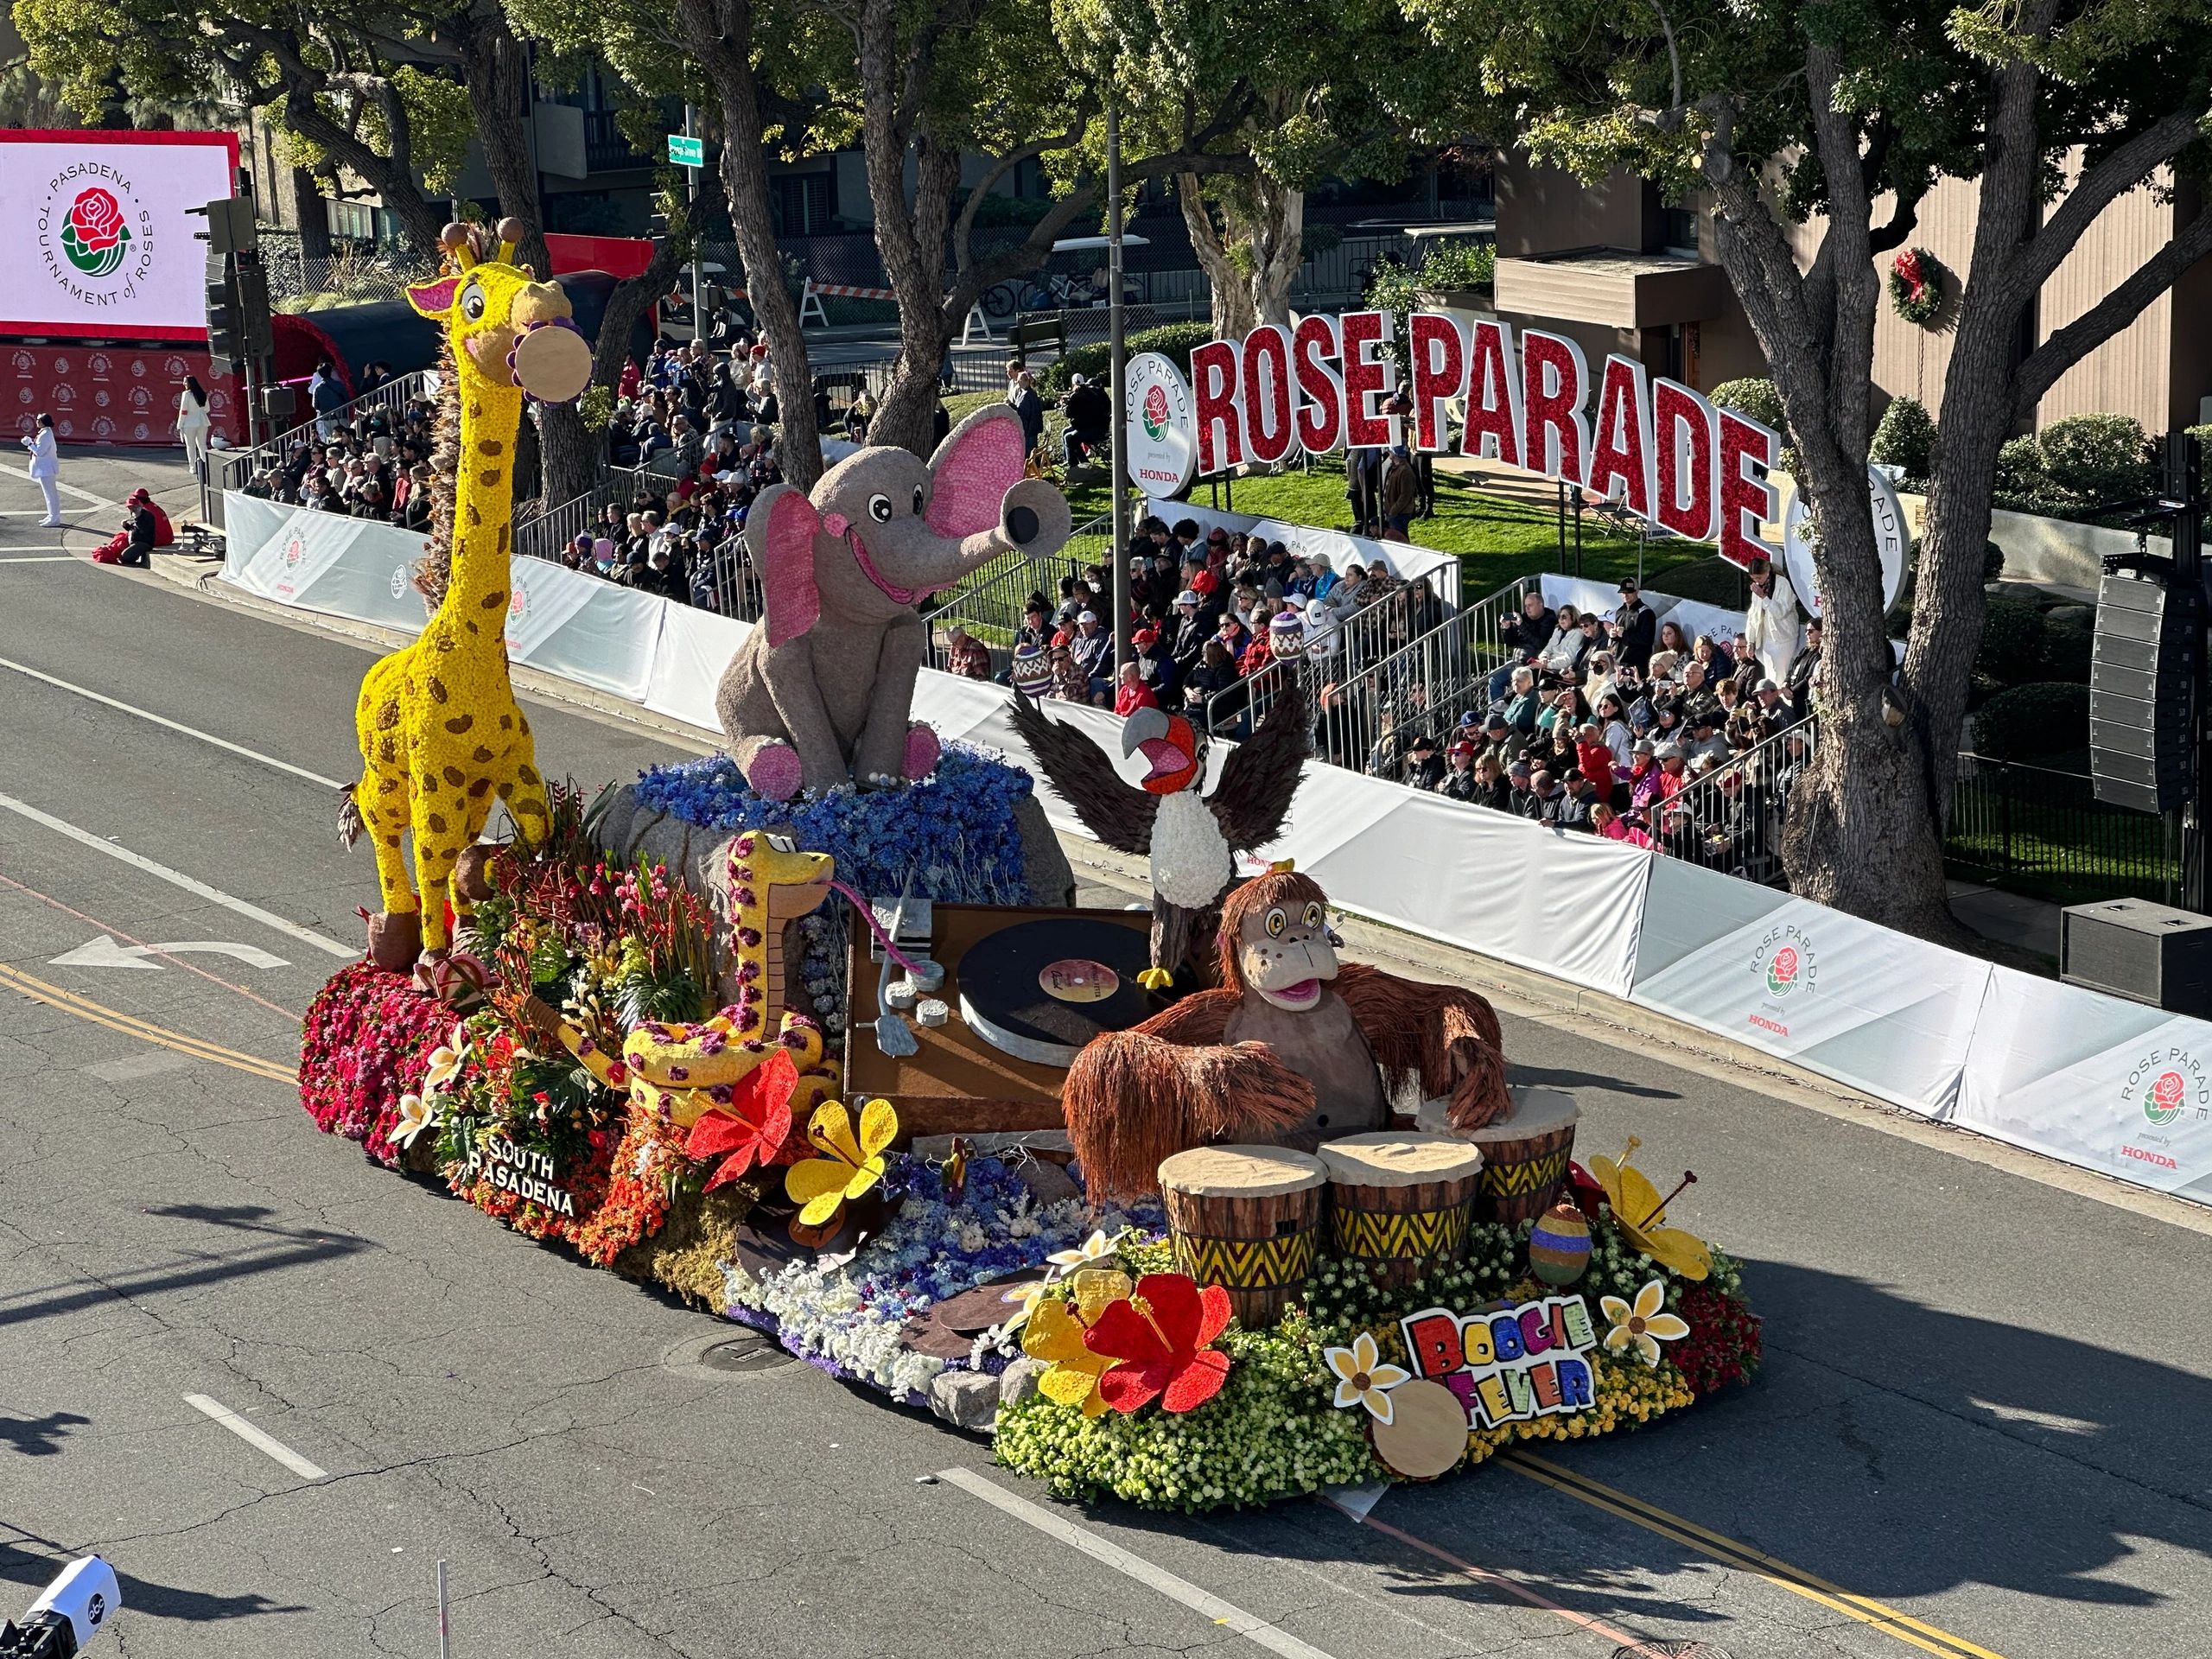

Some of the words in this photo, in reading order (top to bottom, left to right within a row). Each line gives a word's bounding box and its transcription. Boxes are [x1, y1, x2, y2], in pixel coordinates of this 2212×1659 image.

[49, 162, 131, 194] PASADENA
[37, 206, 118, 306] TOURNAMENT
[123, 272, 137, 298] of
[135, 209, 154, 280] ROSES
[1126, 365, 1146, 423] ROSE
[1147, 360, 1189, 429] PARADE
[1139, 468, 1179, 483] HONDA
[1191, 311, 1398, 476] ROSE
[1409, 313, 1782, 573] PARADE
[1867, 479, 1897, 552] ADE
[1247, 856, 1271, 868] HON
[1750, 926, 1781, 974] ROSE
[1786, 925, 1817, 995] PARADE
[1748, 1014, 1789, 1038] HONDA
[2120, 1050, 2162, 1101] ROSE
[2169, 1047, 2209, 1121] PARADE
[468, 1150, 574, 1217] PASADENA
[488, 1135, 554, 1180] SOUTH
[2120, 1145, 2177, 1170] HONDA
[1405, 1300, 1594, 1378] BOOGIE
[1444, 1358, 1592, 1426] FEVER
[88, 1598, 105, 1621] abc
